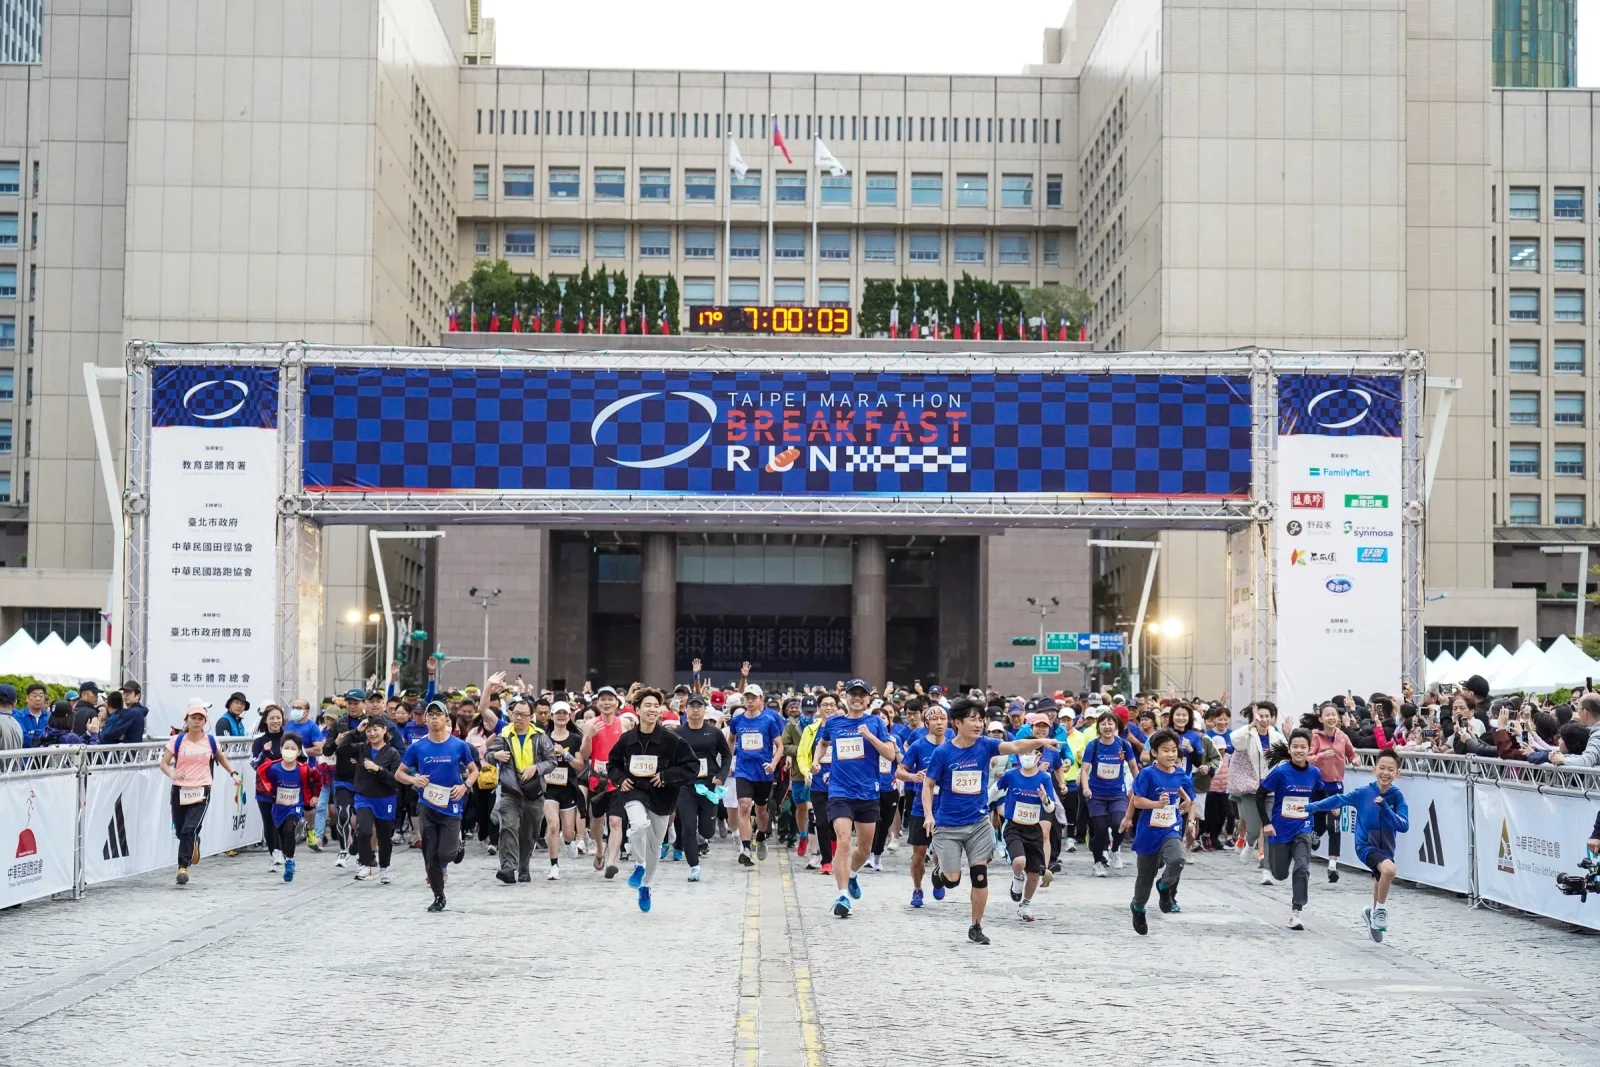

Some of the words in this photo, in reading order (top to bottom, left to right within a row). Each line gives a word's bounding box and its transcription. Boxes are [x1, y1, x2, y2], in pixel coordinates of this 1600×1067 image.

[743, 307, 849, 333] 7:00:03
[727, 392, 807, 408] TAIPEI
[819, 393, 962, 409] MARATHON
[727, 410, 968, 443] BREAKFAST
[726, 445, 837, 473] RUN
[182, 460, 246, 471] 教育部體育署
[1323, 467, 1370, 478] FamilyMart
[188, 517, 238, 528] 臺北市政府
[1353, 529, 1394, 538] synmosa
[172, 541, 253, 552] 中華民國田徑協會
[171, 566, 252, 577] 中華民國路跑協會
[170, 627, 252, 638] 臺北市政府體育局
[169, 672, 250, 683] 臺北市體育總會
[840, 744, 861, 753] 2318
[633, 762, 654, 771] 2316
[955, 778, 978, 787] 2317
[428, 790, 444, 801] 572
[1017, 809, 1037, 819] 3916
